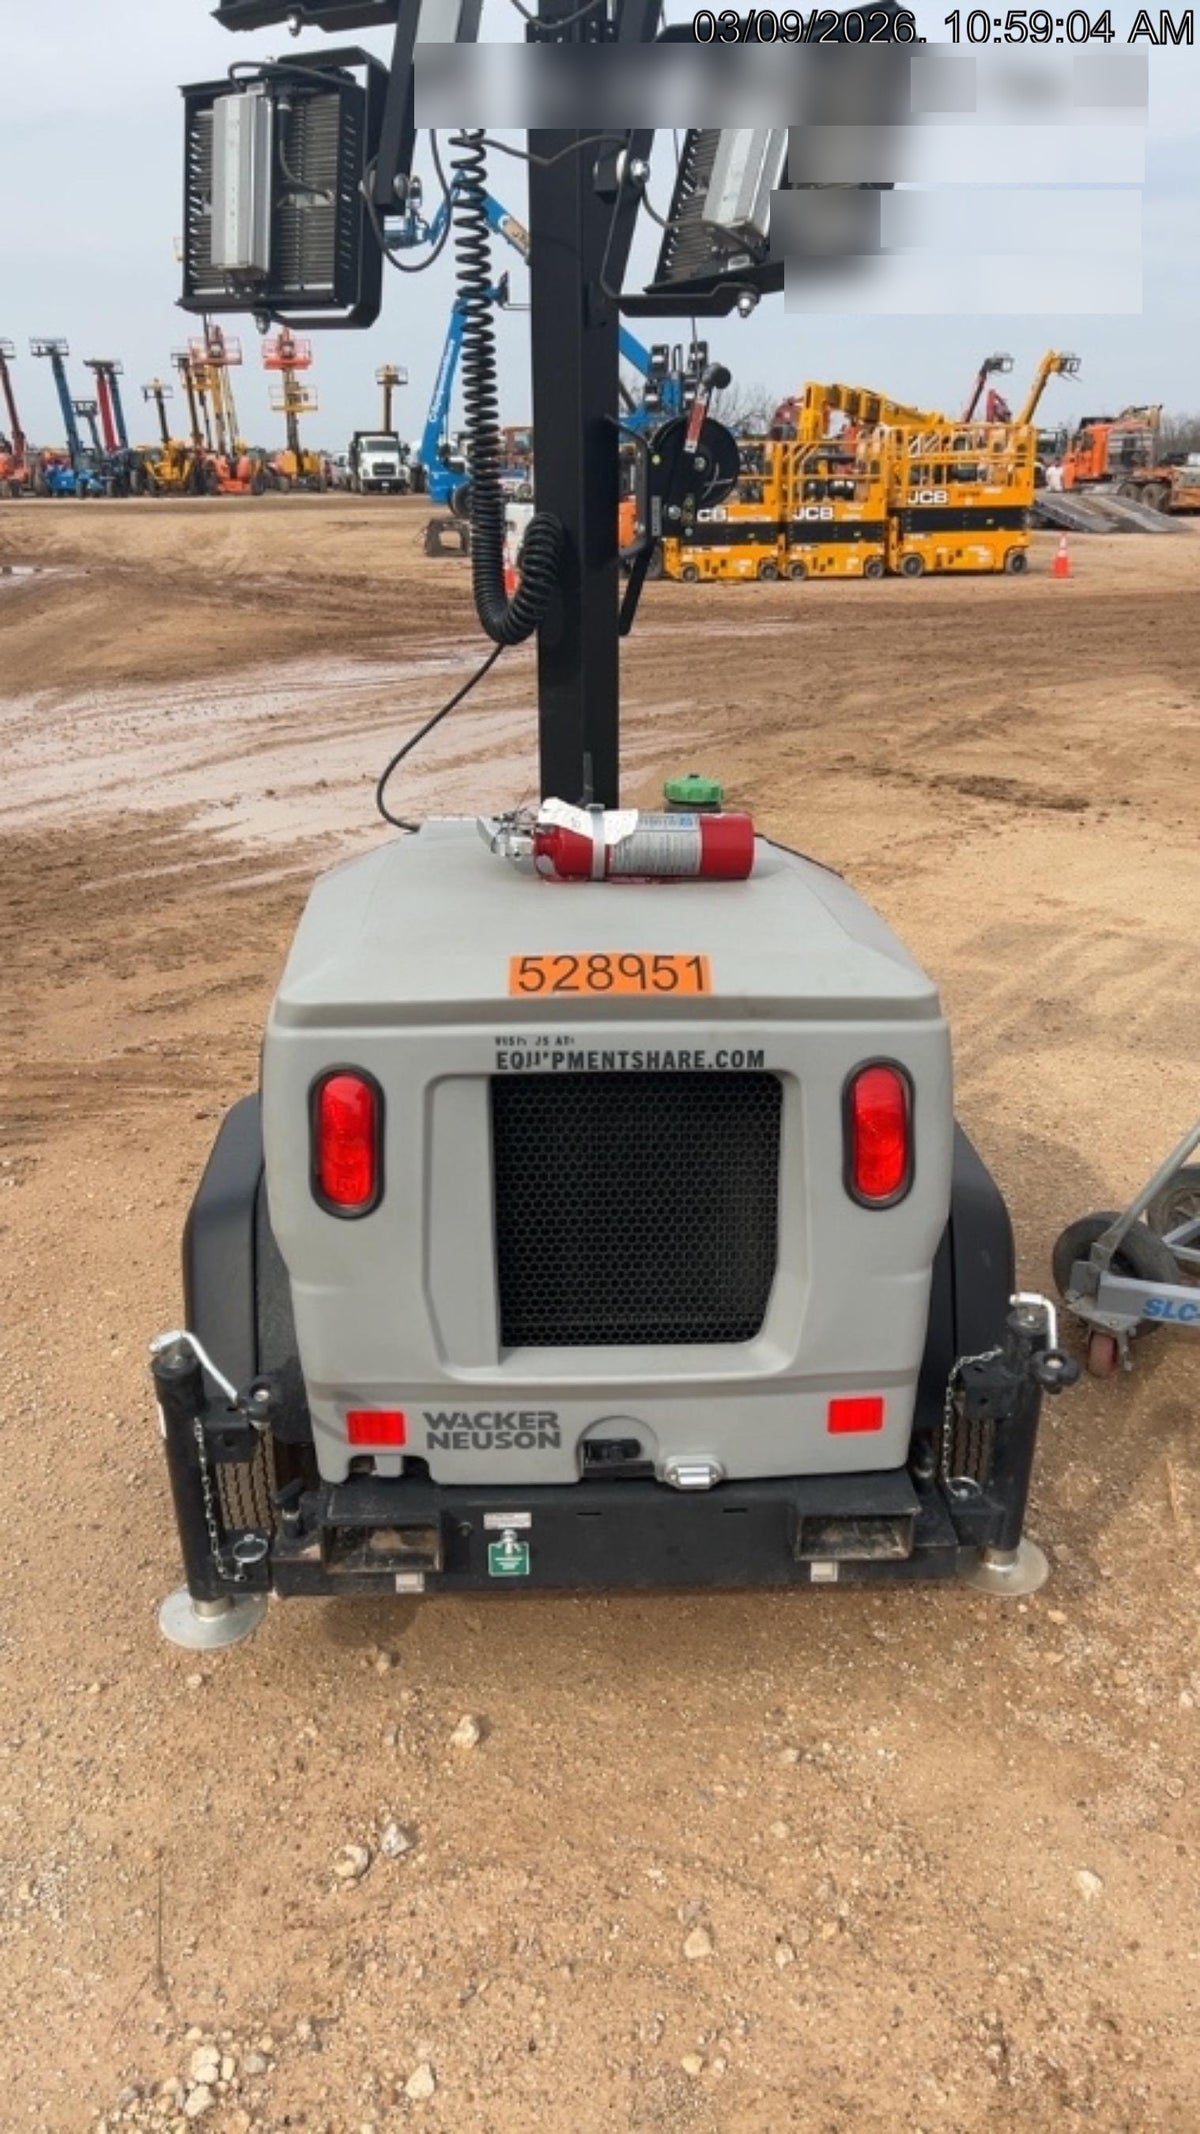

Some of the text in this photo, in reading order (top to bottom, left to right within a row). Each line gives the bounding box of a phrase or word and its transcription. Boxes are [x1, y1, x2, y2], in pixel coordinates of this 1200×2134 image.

[908, 490, 947, 504] JCB
[696, 506, 728, 522] CB
[793, 507, 834, 520] JCB
[518, 953, 704, 992] 528951
[422, 1411, 560, 1430] WACKER
[426, 1431, 561, 1450] NEUSON
